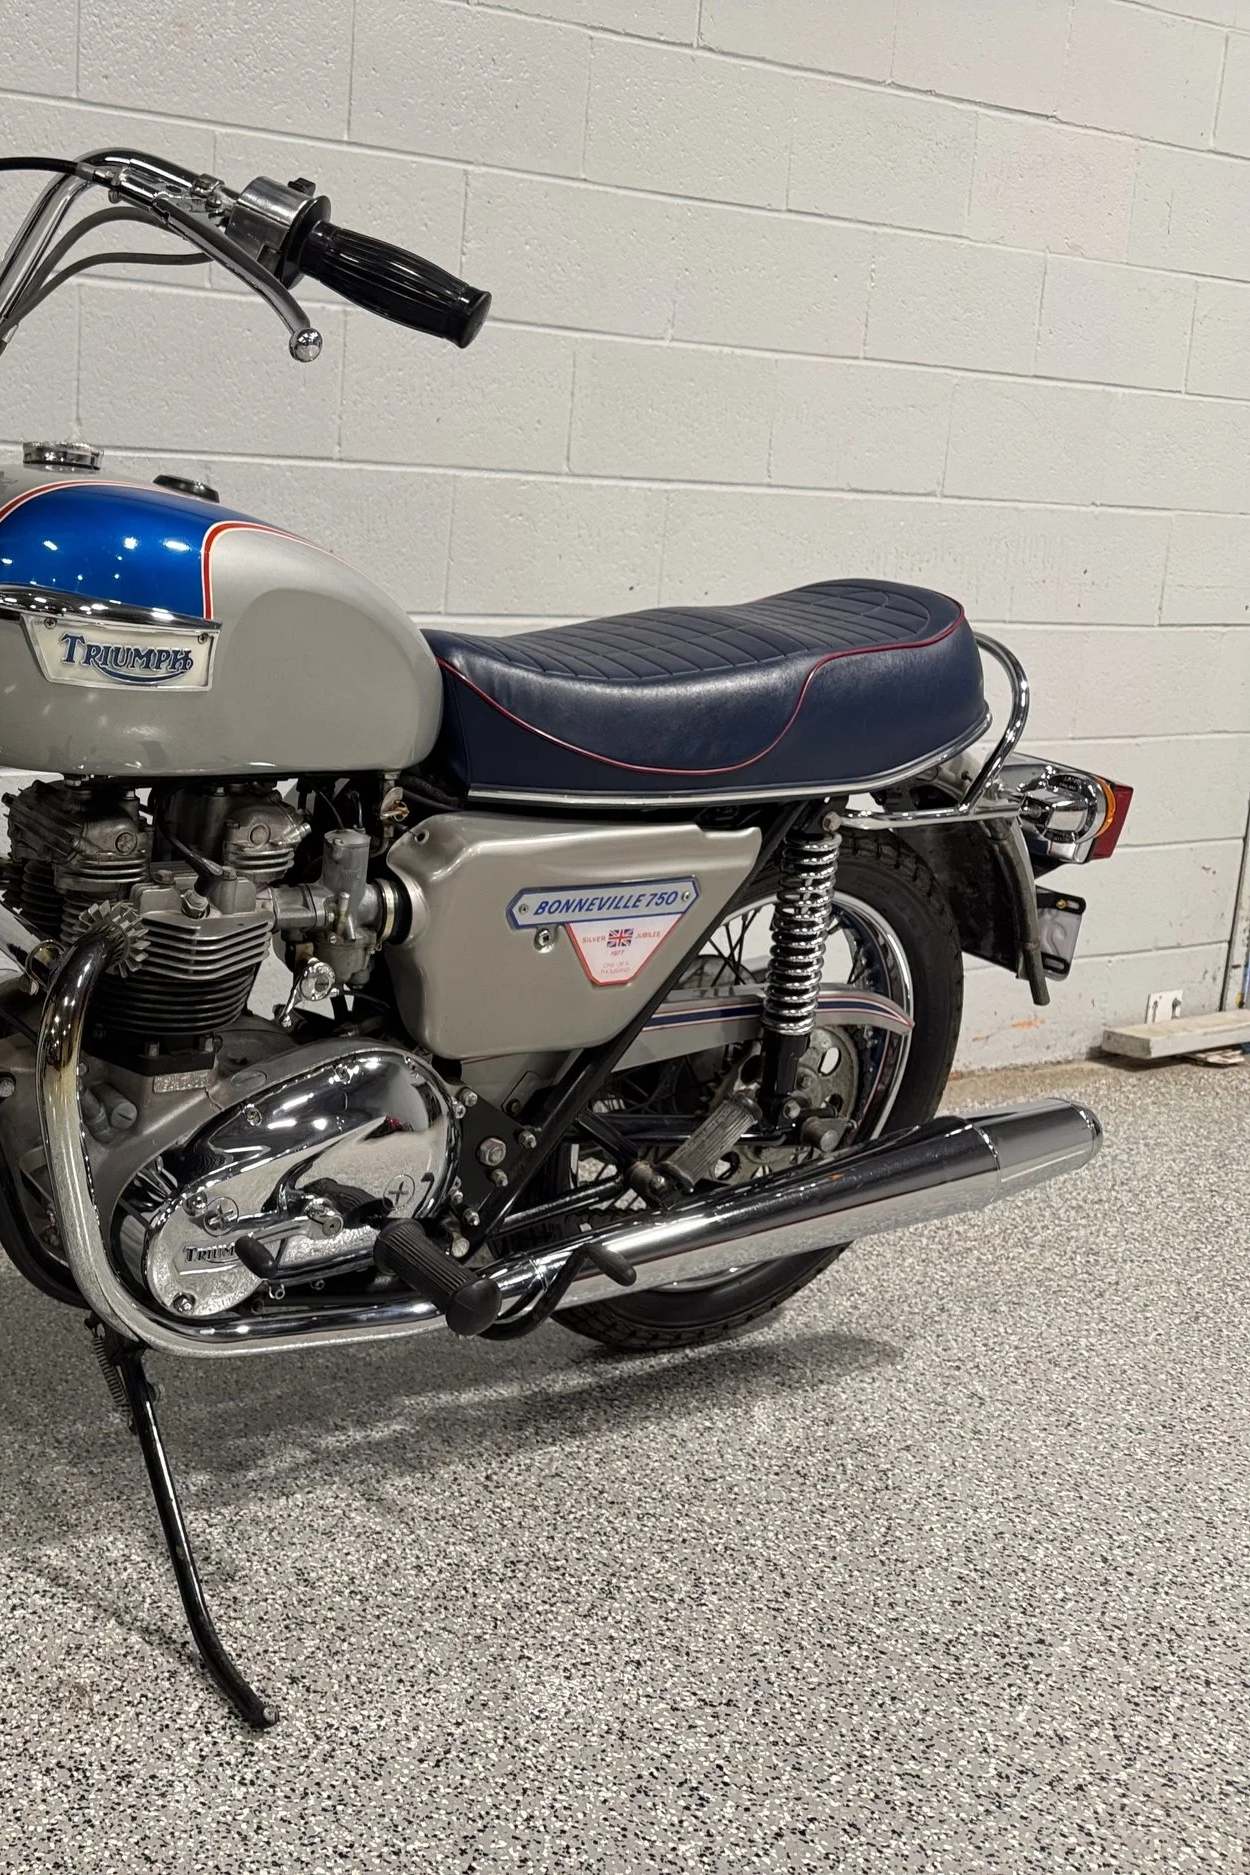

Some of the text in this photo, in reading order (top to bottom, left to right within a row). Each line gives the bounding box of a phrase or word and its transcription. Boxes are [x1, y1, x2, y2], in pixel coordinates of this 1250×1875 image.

[60, 633, 194, 684] TRIUMPH
[533, 890, 679, 916] BONNEVILLE 750
[582, 931, 661, 944] SILVER JUBILEE
[610, 949, 625, 957] 1977
[183, 1241, 236, 1263] TRIUM
